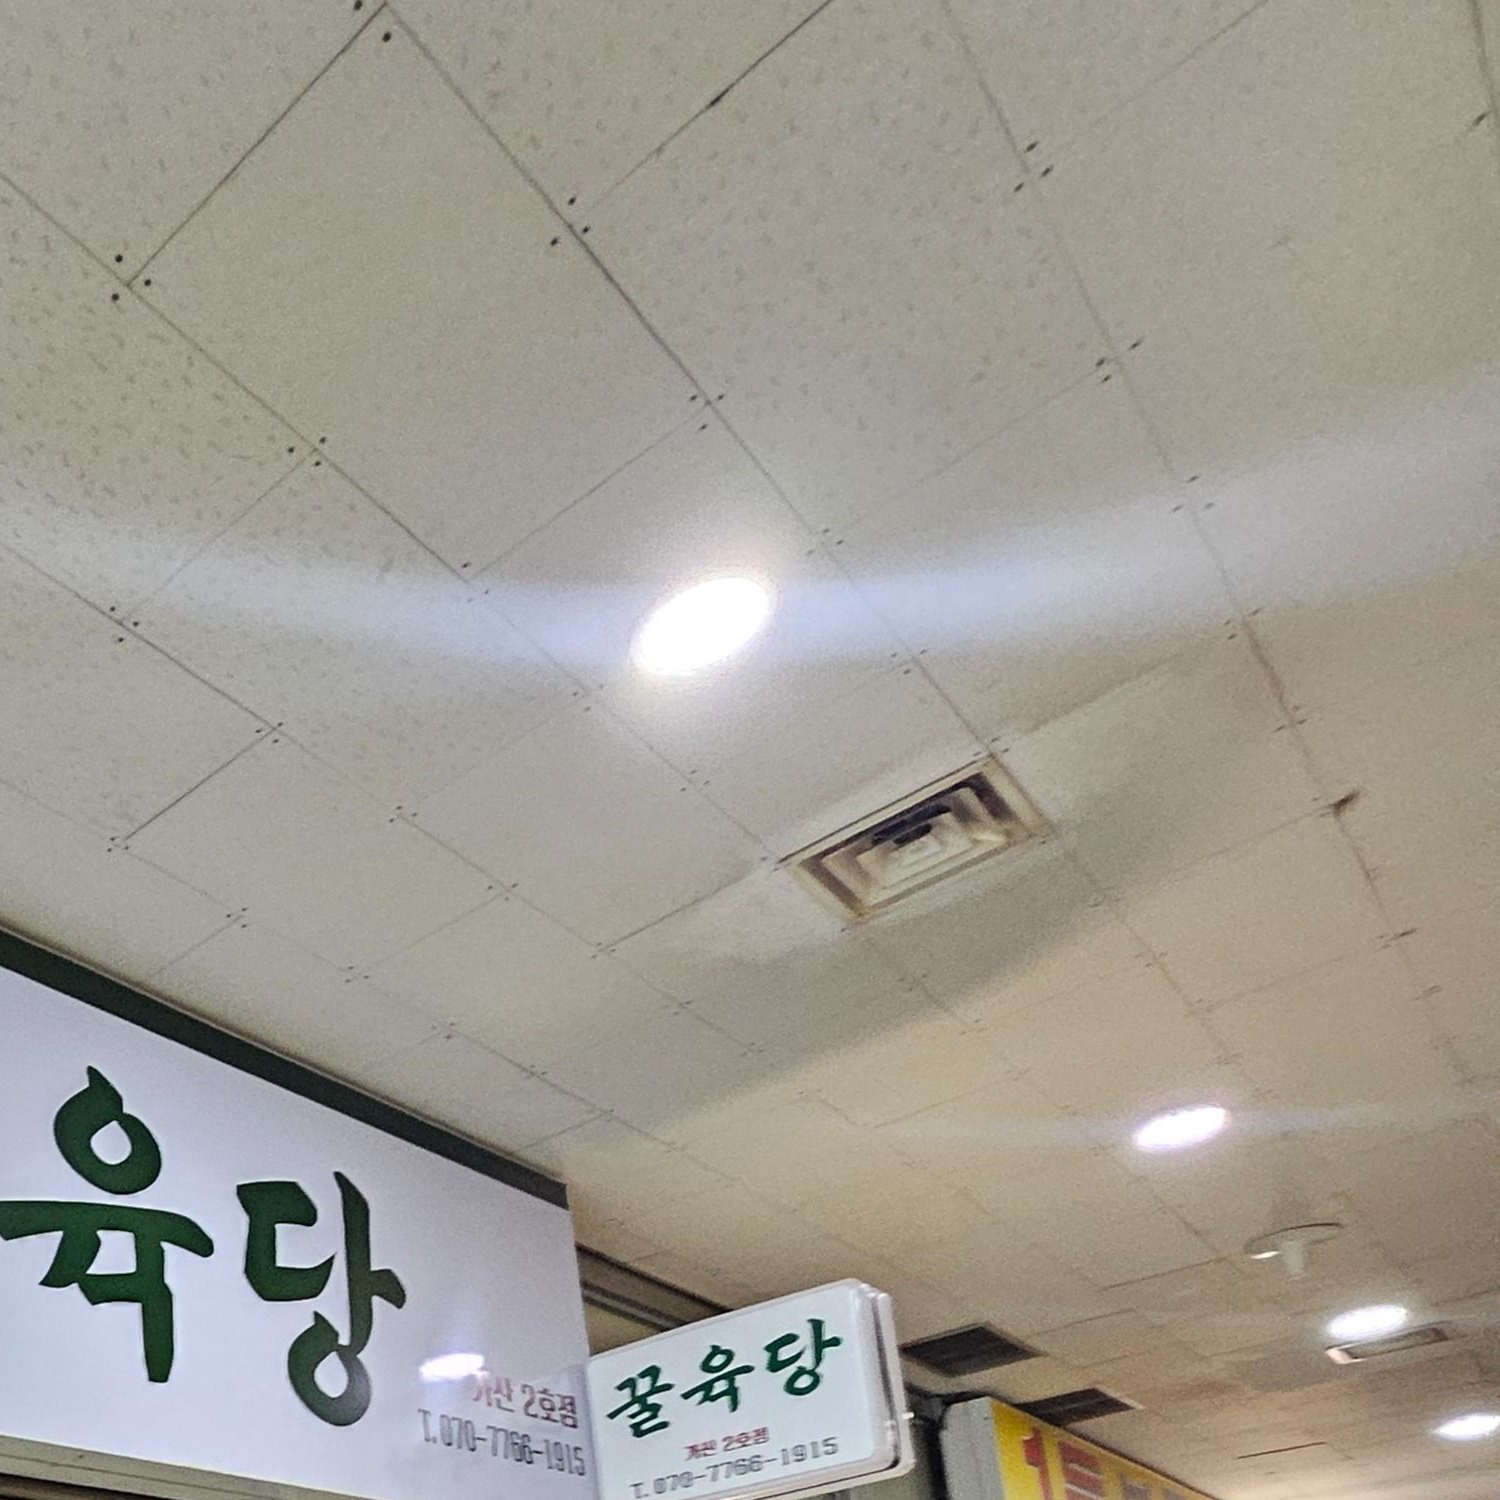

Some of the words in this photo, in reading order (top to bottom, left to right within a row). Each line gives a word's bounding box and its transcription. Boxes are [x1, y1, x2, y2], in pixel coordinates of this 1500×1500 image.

[606, 1318, 843, 1439] 꿀육당
[520, 1383, 579, 1430] 2호점
[722, 1426, 770, 1452] 2호점
